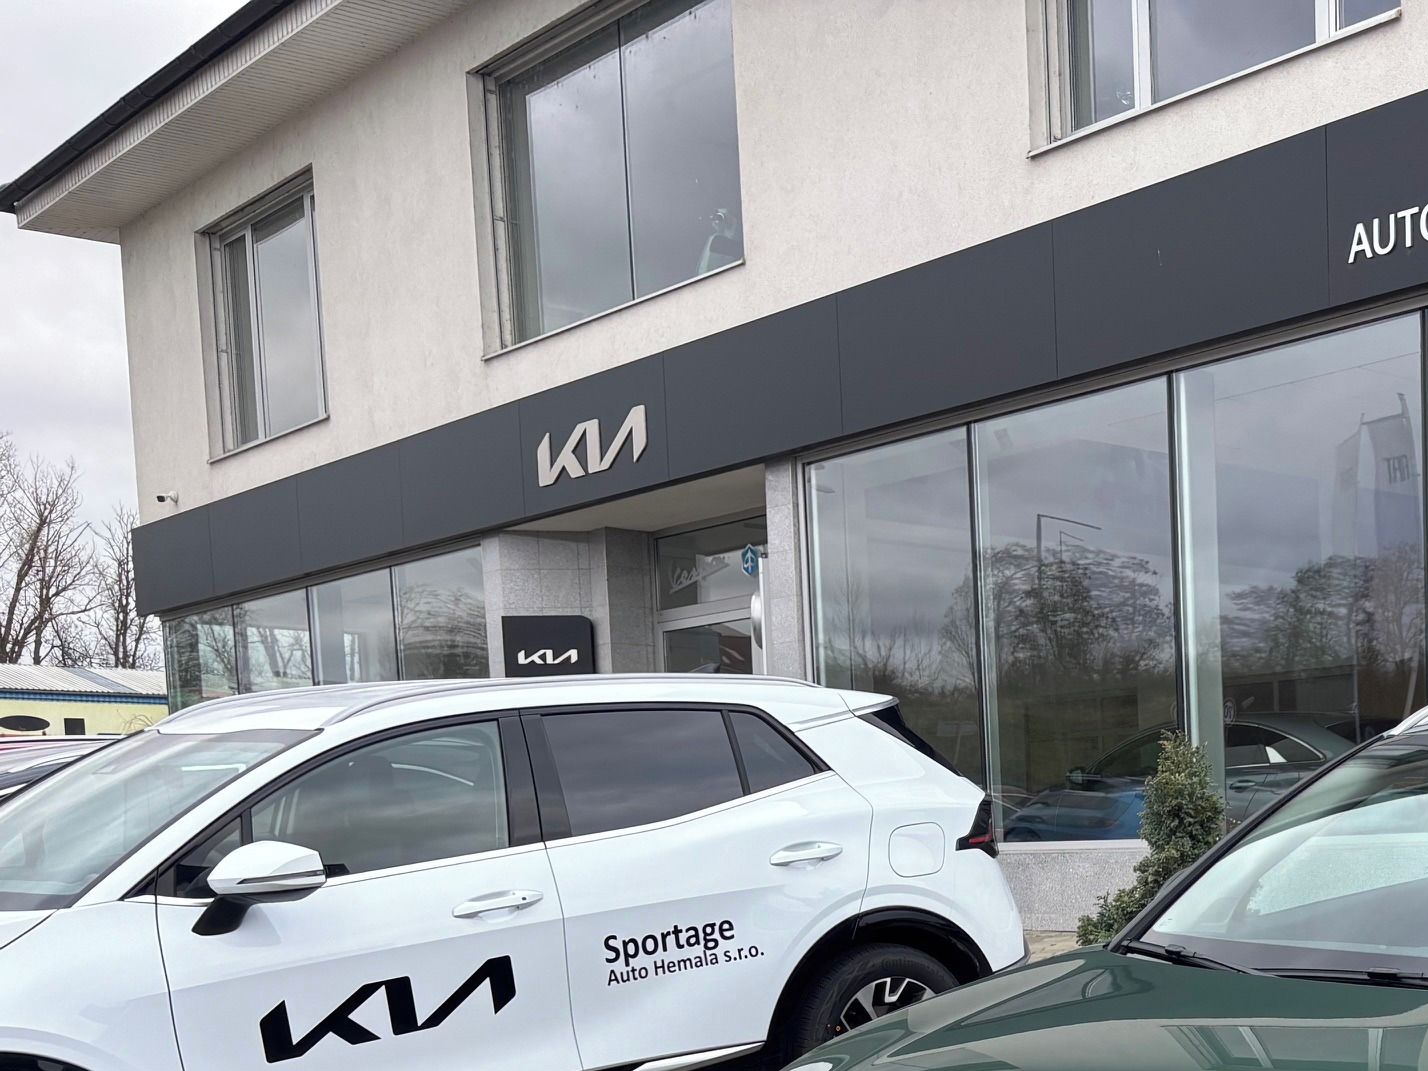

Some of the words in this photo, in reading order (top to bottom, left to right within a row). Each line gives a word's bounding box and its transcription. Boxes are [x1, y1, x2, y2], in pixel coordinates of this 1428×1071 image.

[537, 404, 648, 487] KIA
[517, 649, 578, 664] KIA
[604, 919, 735, 967] Sportage
[607, 966, 648, 986] Auto
[654, 951, 719, 976] Hemala
[724, 945, 765, 963] s.r.o.
[259, 955, 516, 1064] KIA
